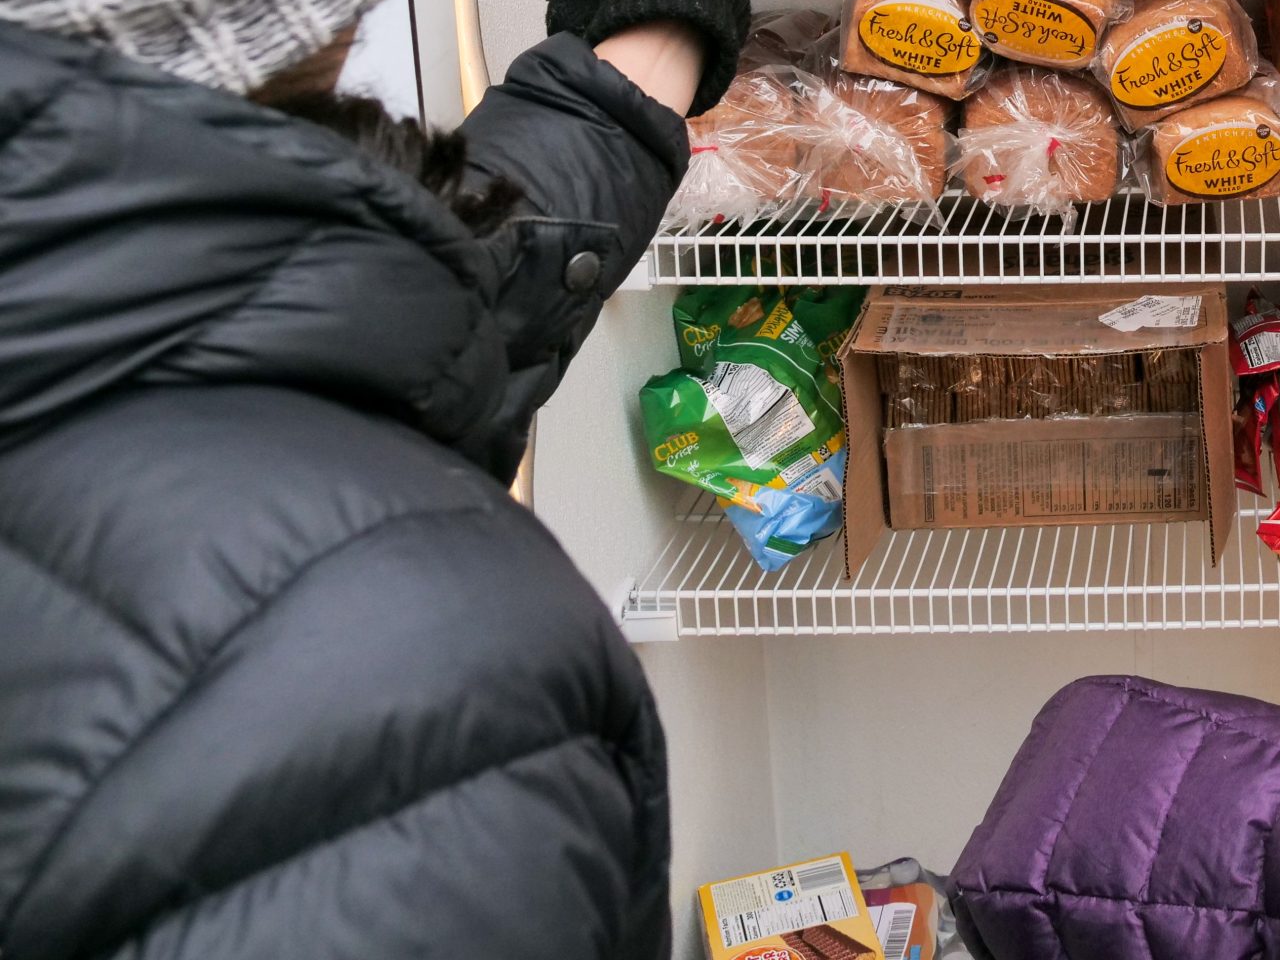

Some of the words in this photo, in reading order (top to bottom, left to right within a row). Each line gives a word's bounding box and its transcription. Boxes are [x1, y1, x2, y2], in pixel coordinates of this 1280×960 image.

[1012, 1, 1063, 24] WHITE
[1027, 0, 1052, 10] BREAD
[980, 7, 1020, 34] Soft
[1022, 21, 1036, 38] &
[869, 11, 918, 45] Fresh
[918, 30, 933, 48] &
[935, 32, 981, 61] Soft
[1038, 25, 1086, 57] Fresh
[1131, 29, 1187, 59] ENRICHED
[892, 47, 942, 69] WHITE
[903, 61, 927, 71] BREAD
[1116, 56, 1168, 94] Fresh
[1168, 52, 1183, 72] &
[1181, 32, 1221, 69] Soft
[1153, 69, 1203, 99] WHITE
[1171, 85, 1193, 99] BREAD
[1174, 149, 1224, 177] Fresh
[1226, 149, 1240, 169] &
[1241, 140, 1280, 171] Soft
[1204, 173, 1254, 189] WHITE
[654, 432, 700, 461] CLUB
[666, 443, 700, 468] Crisps
[1164, 493, 1172, 508] 120
